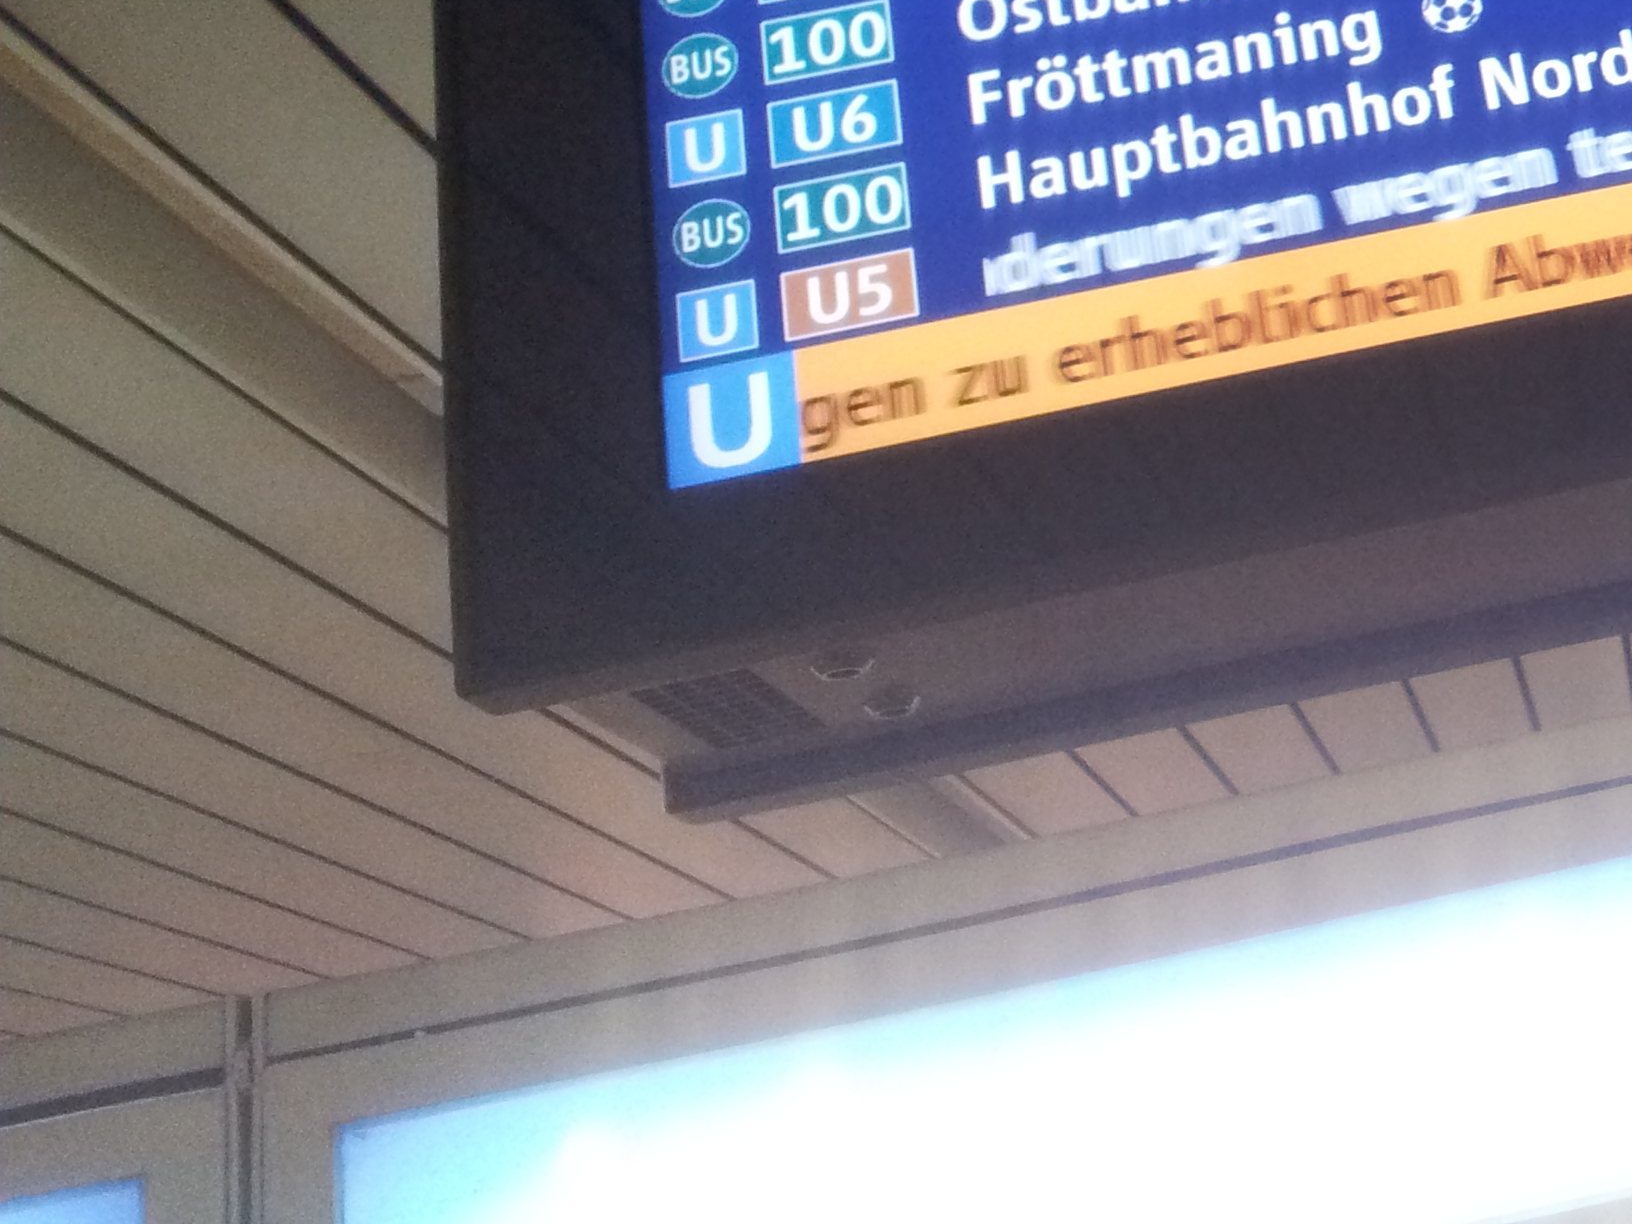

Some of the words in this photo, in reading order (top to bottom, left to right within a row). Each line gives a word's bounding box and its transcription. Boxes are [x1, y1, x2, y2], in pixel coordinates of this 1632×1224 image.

[669, 45, 732, 85] BUS
[768, 11, 887, 74] 100
[683, 122, 725, 173] U
[791, 93, 878, 153] U6
[967, 9, 1382, 125] Fröttmaning
[680, 211, 745, 254] BUS
[781, 175, 903, 243] 100
[977, 64, 1455, 209] Hauptbahnhof
[695, 293, 739, 347] U
[806, 264, 893, 325] U5
[1333, 147, 1558, 221] wegen
[687, 371, 772, 468] U
[801, 375, 927, 452] gen
[950, 354, 1027, 406] zu
[1055, 267, 1461, 383] erheblichen
